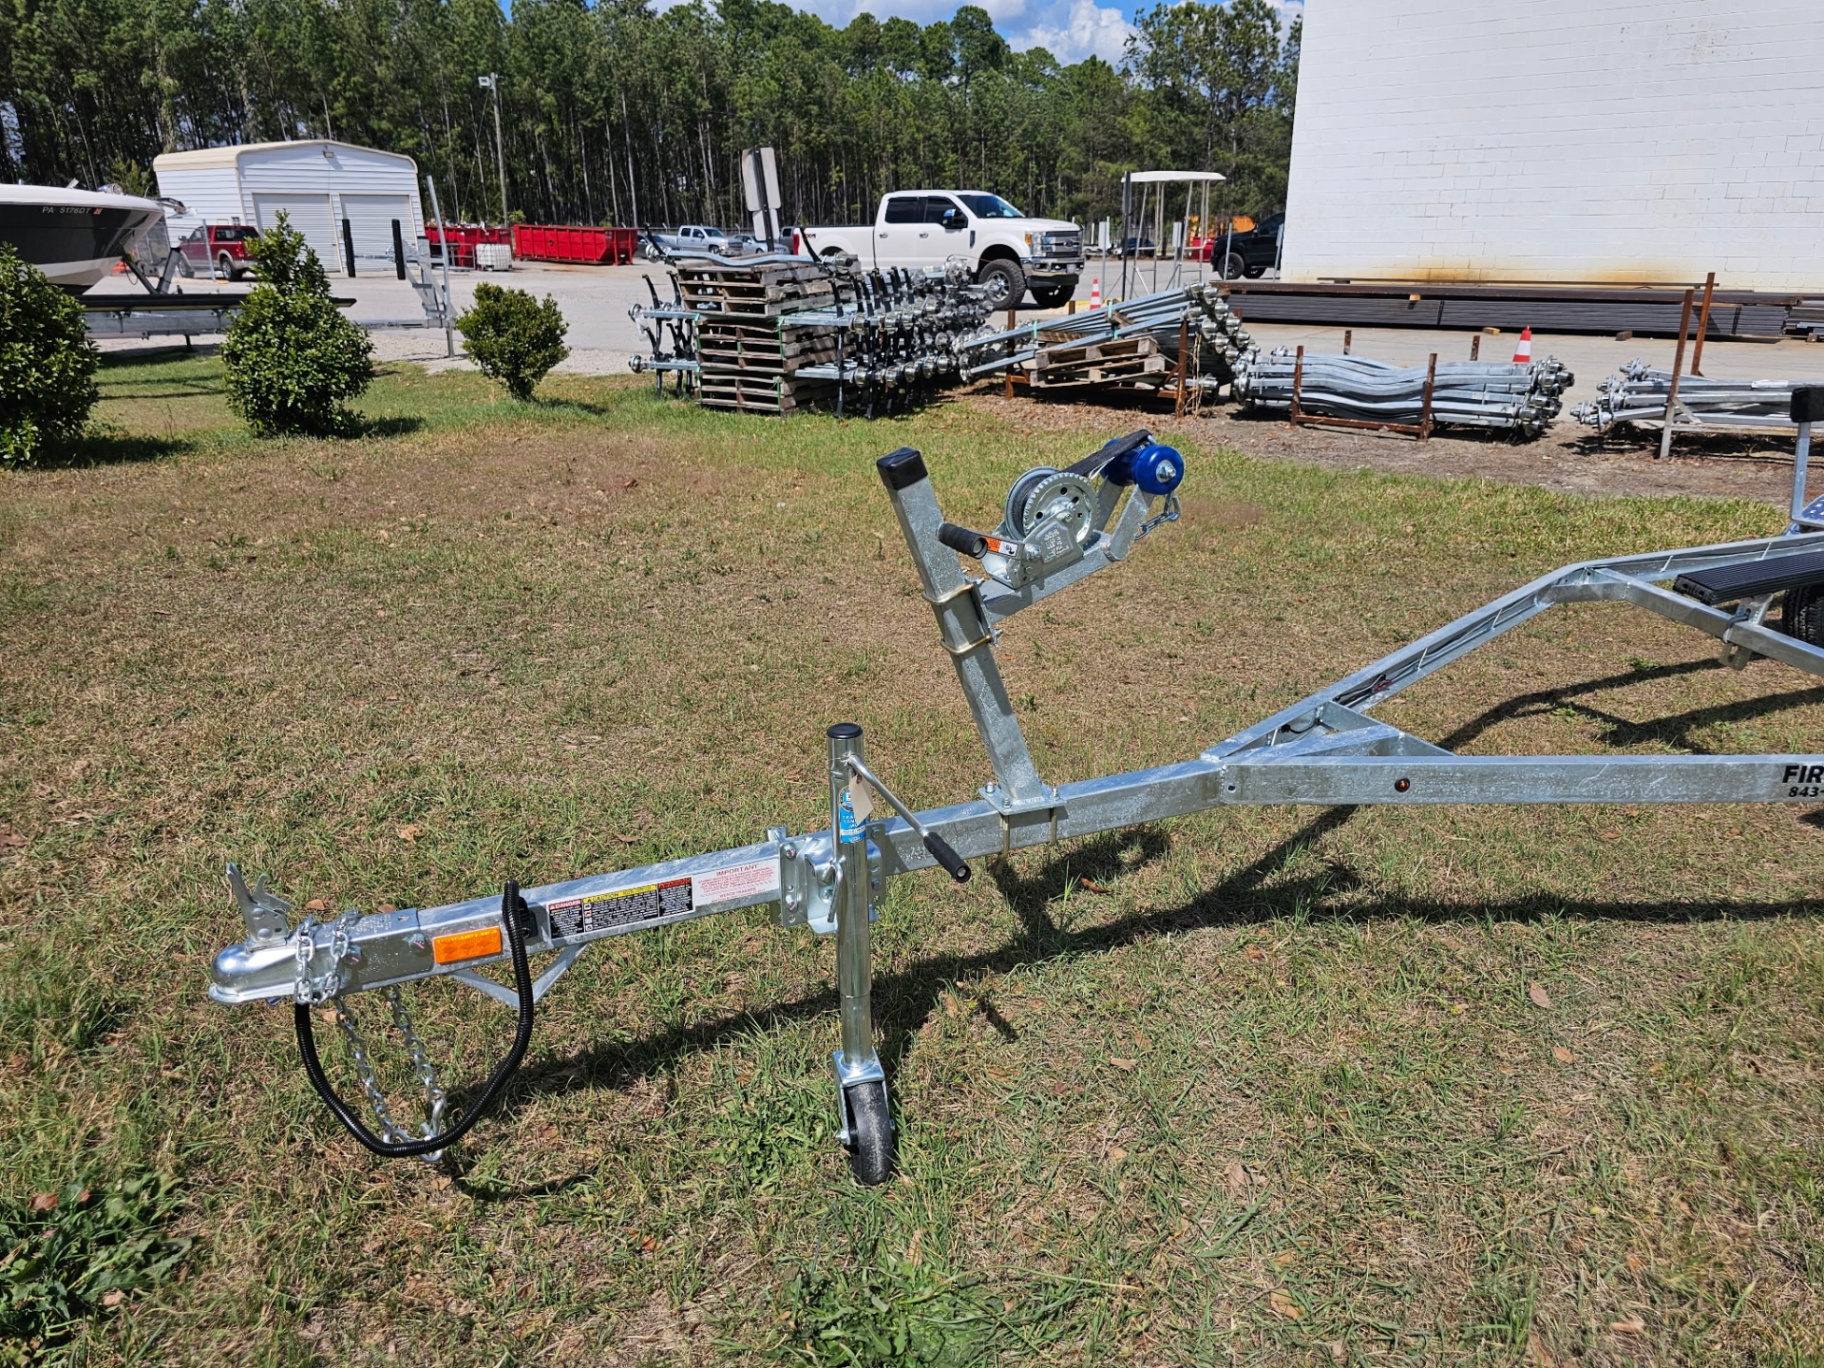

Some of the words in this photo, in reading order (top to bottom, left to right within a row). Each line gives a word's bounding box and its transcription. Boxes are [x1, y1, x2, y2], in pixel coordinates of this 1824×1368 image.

[42, 206, 54, 214] PA
[1782, 765, 1824, 783] FIR
[716, 865, 757, 875] IMPORTANT
[555, 899, 580, 909] DANGER
